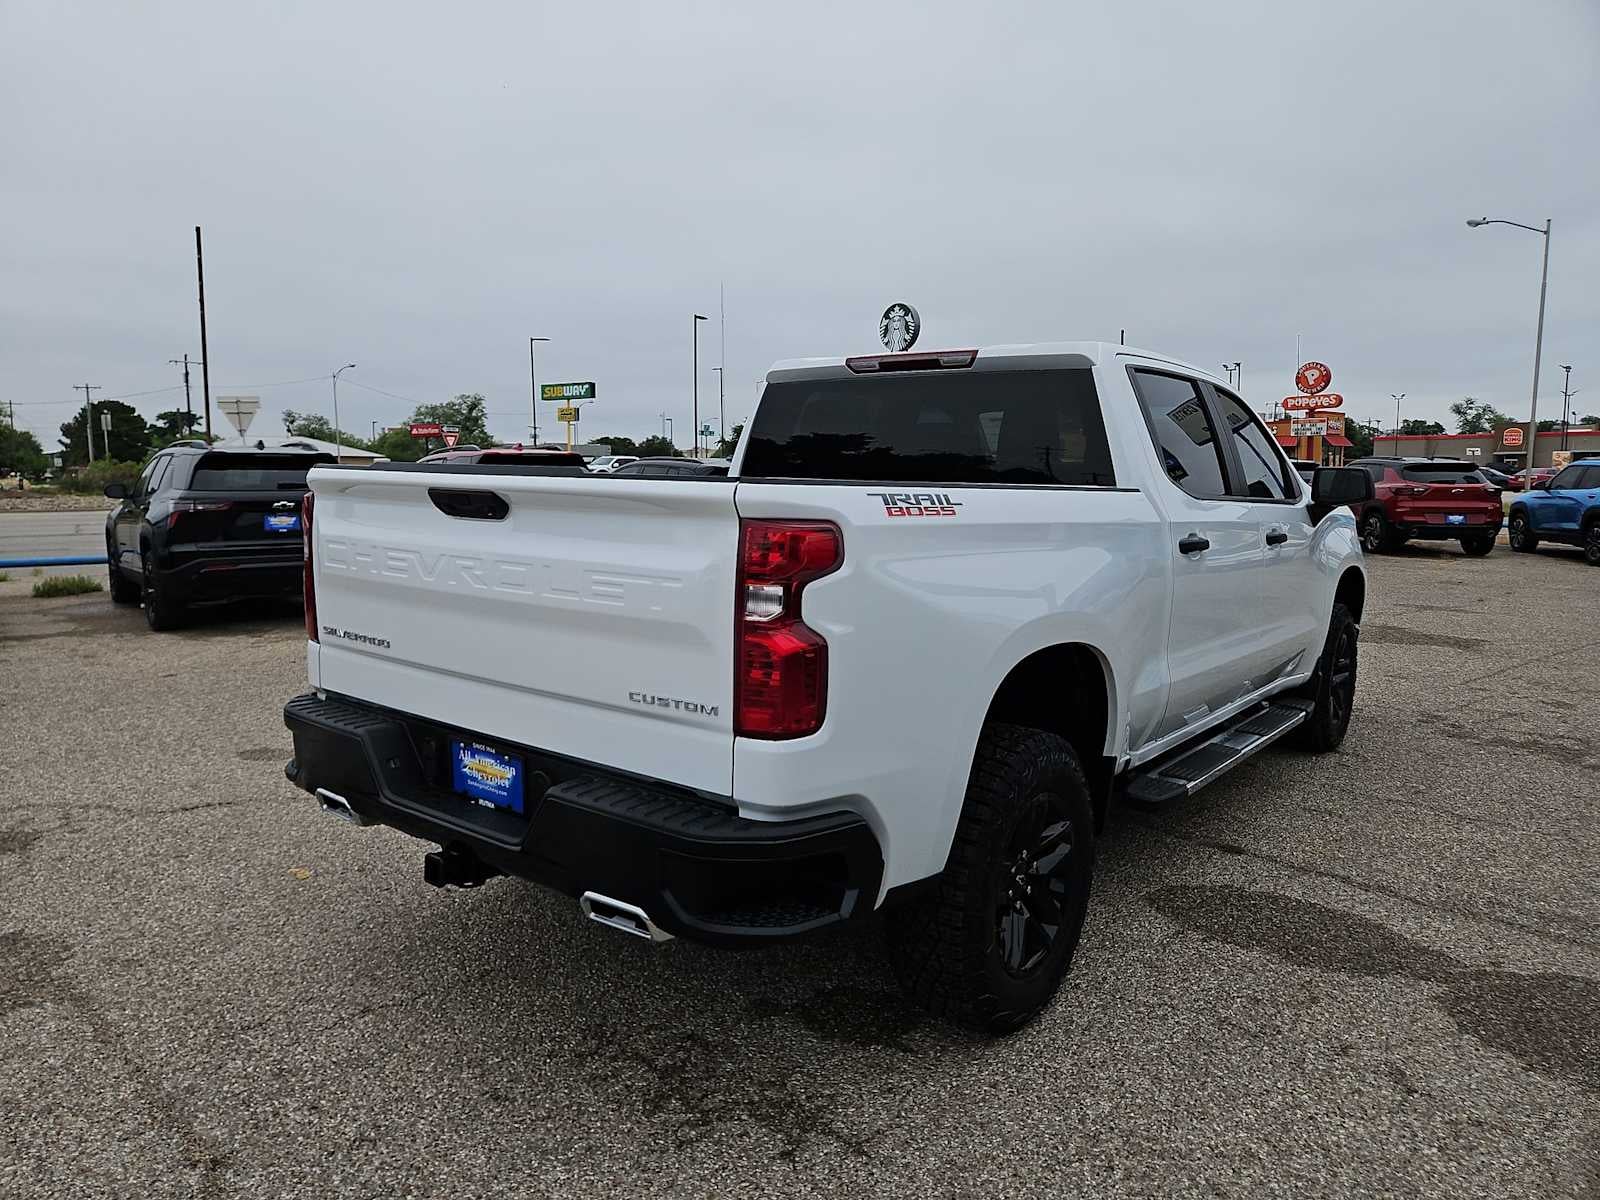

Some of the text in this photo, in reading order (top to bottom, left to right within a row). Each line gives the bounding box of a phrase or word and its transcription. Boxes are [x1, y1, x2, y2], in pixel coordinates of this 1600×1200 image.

[543, 384, 589, 398] SUBWAY
[867, 493, 963, 506] TRAIL
[885, 506, 956, 517] BOSS
[323, 539, 683, 611] CHEVROLET
[629, 691, 719, 717] CUSTOM
